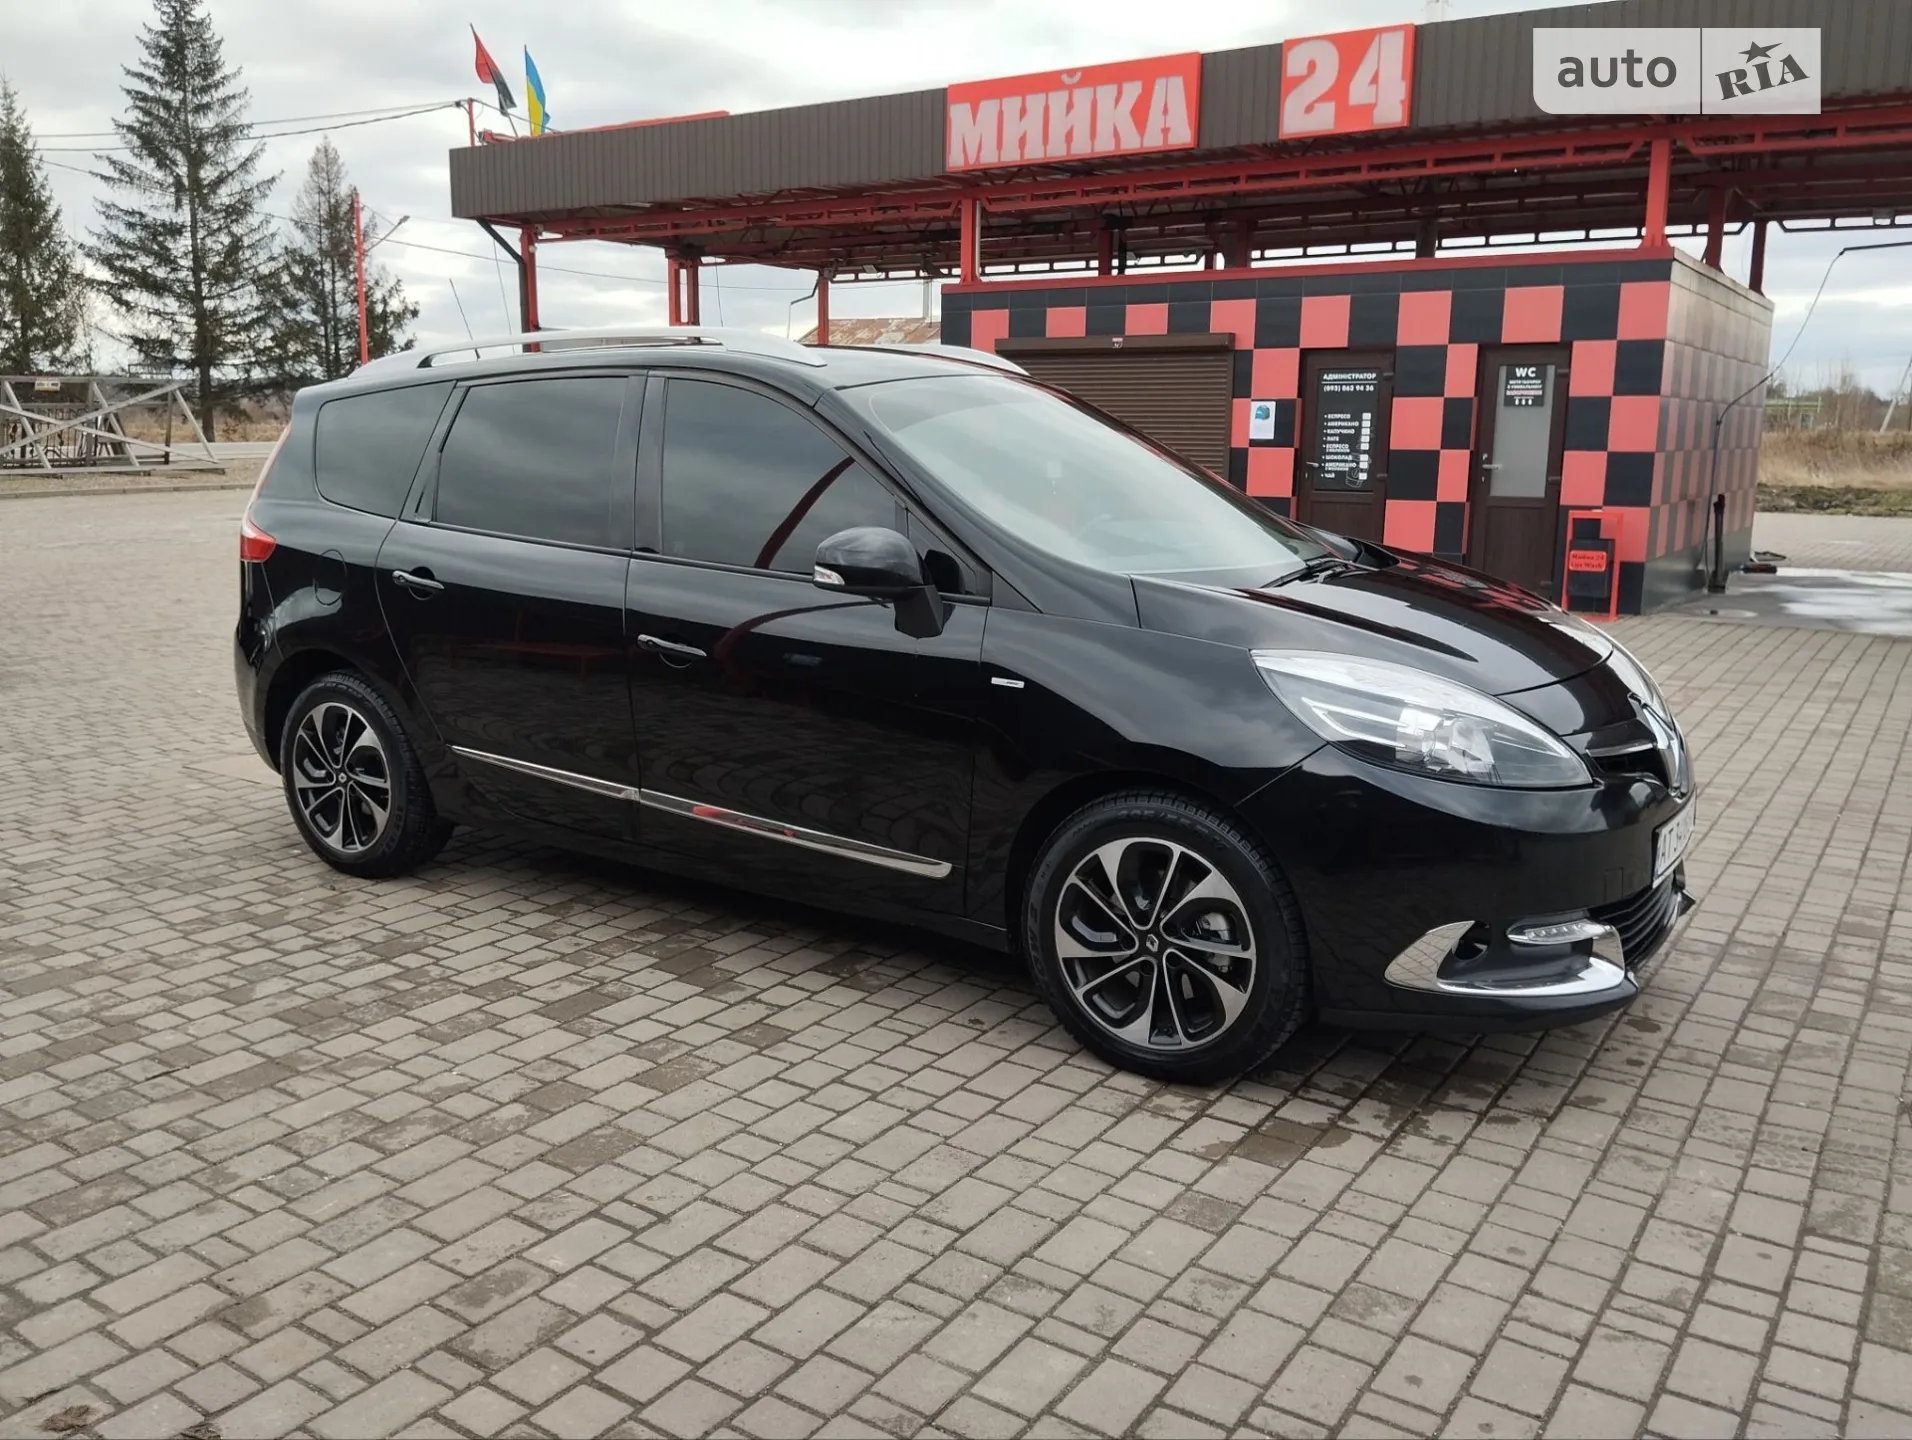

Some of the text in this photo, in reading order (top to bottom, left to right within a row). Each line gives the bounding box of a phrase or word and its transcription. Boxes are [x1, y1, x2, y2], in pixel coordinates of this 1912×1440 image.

[948, 30, 1406, 168] МИЙКА 24
[1515, 366, 1537, 378] WC
